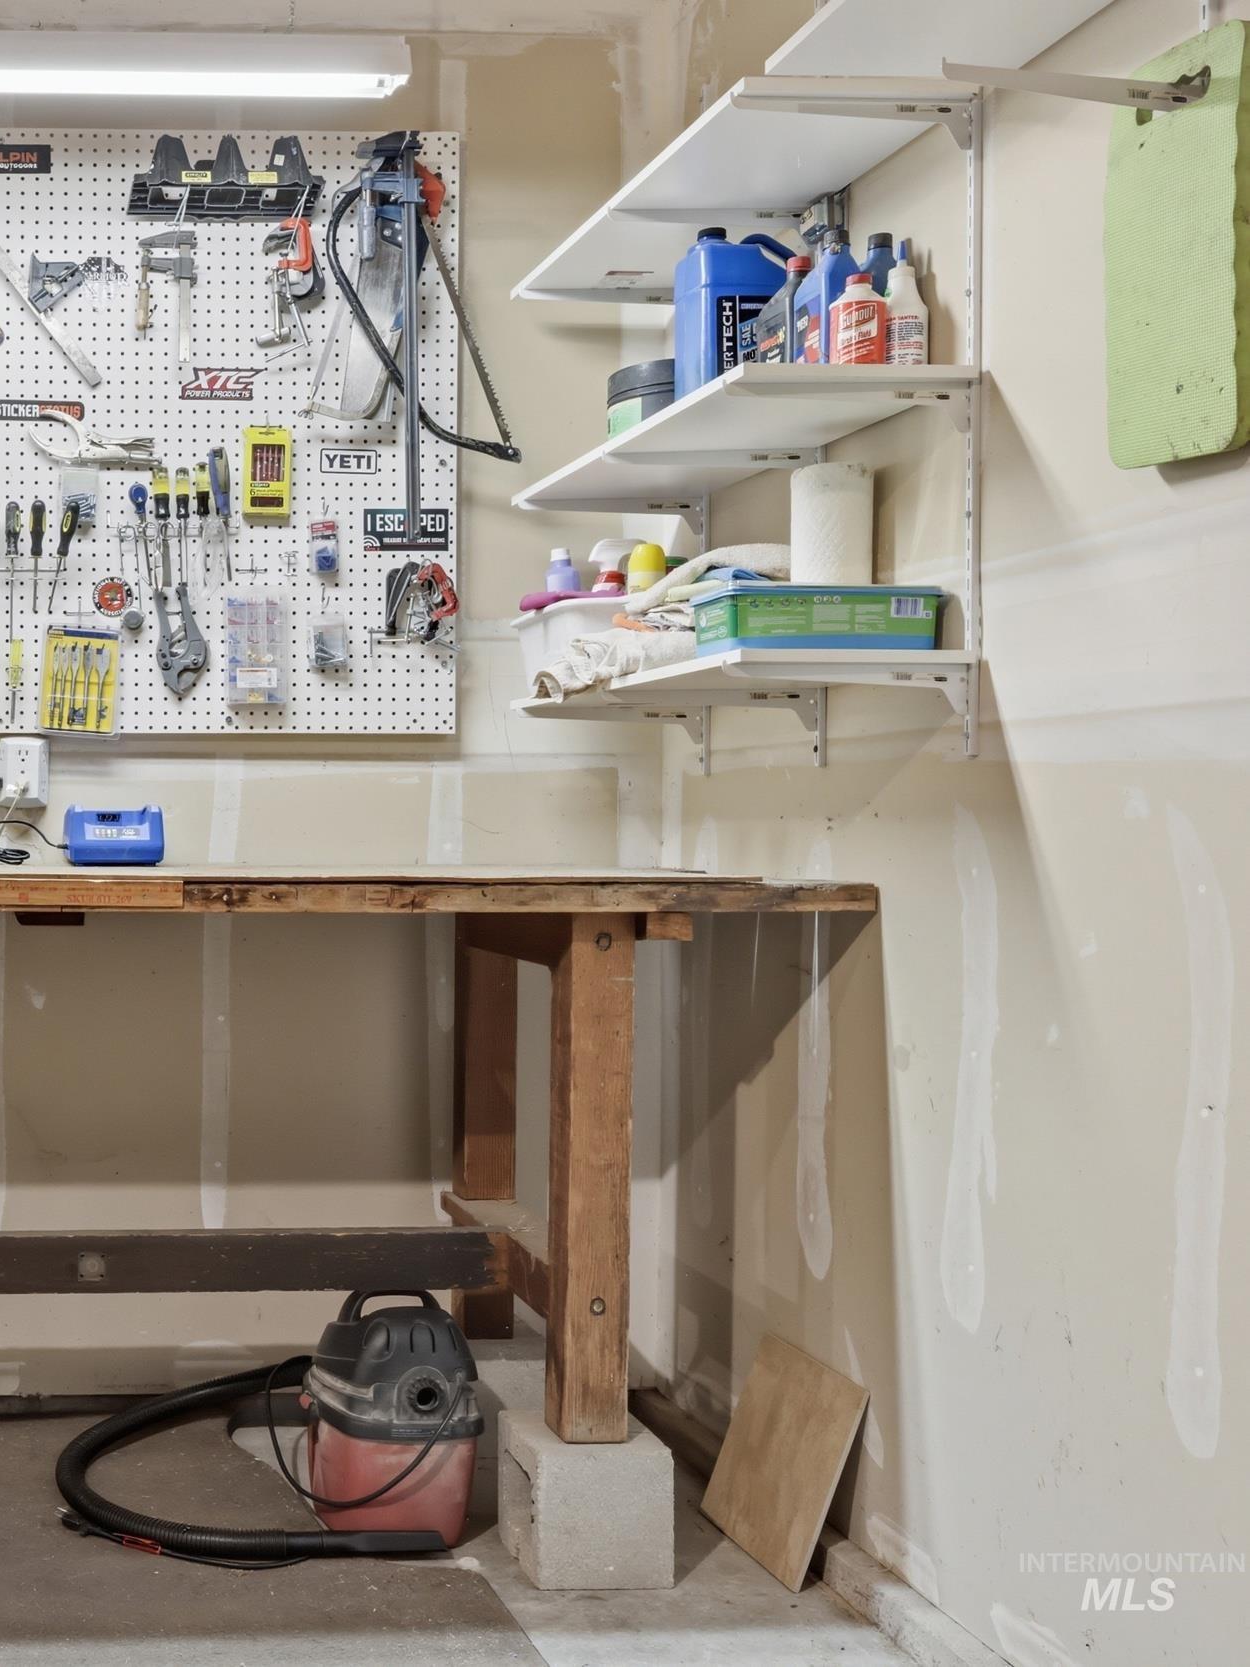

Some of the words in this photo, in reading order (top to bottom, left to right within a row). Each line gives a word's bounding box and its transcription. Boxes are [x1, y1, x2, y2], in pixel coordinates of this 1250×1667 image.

[186, 371, 254, 389] XTC
[325, 453, 372, 469] YETI
[367, 514, 371, 531] I
[376, 513, 445, 532] ESCPED
